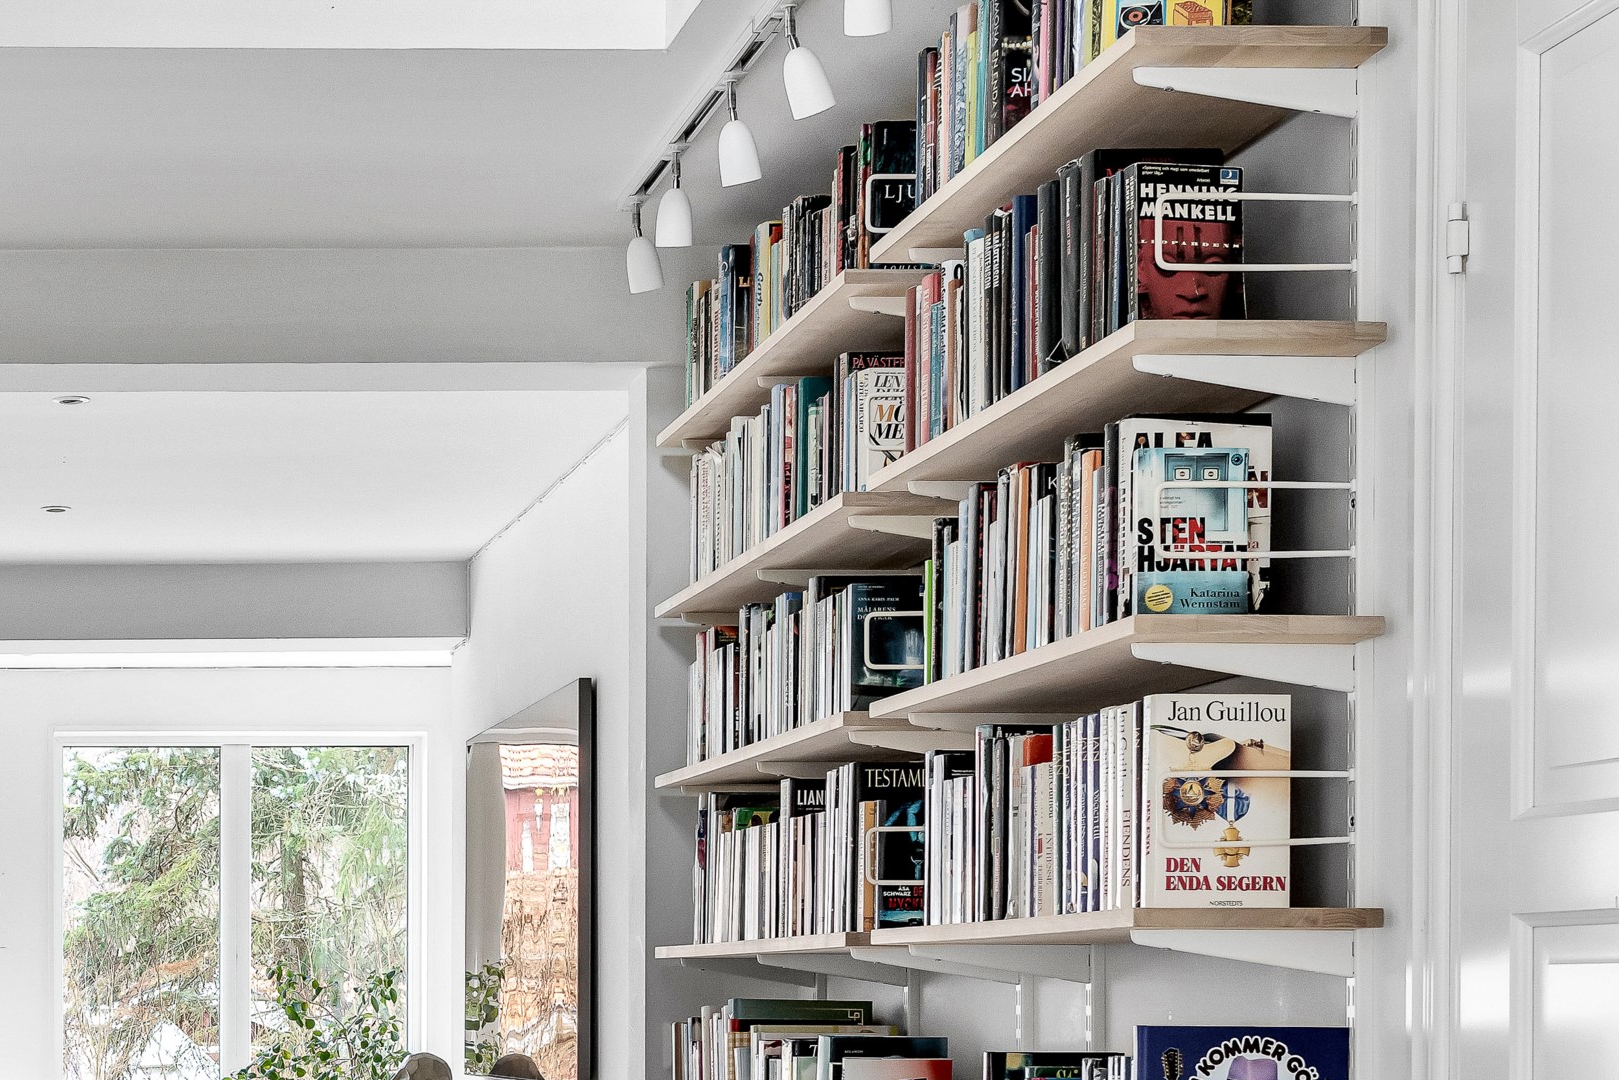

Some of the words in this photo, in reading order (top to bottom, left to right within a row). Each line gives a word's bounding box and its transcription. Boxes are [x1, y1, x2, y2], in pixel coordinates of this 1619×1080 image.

[992, 50, 999, 70] EN
[1140, 202, 1236, 221] MANKELL
[852, 355, 866, 369] PÅ
[1138, 517, 1206, 545] STEN
[1190, 588, 1240, 598] Katarina
[1180, 598, 1240, 609] Wennstam
[1168, 700, 1201, 721] Jan
[1206, 700, 1286, 722] Guillou
[1092, 737, 1100, 762] JAN
[1122, 809, 1131, 887] FIENDENS
[1165, 857, 1201, 873] DEN
[1165, 875, 1212, 890] ENDA
[1216, 875, 1286, 891] SEGERN
[1197, 1037, 1286, 1076] KOMMER
